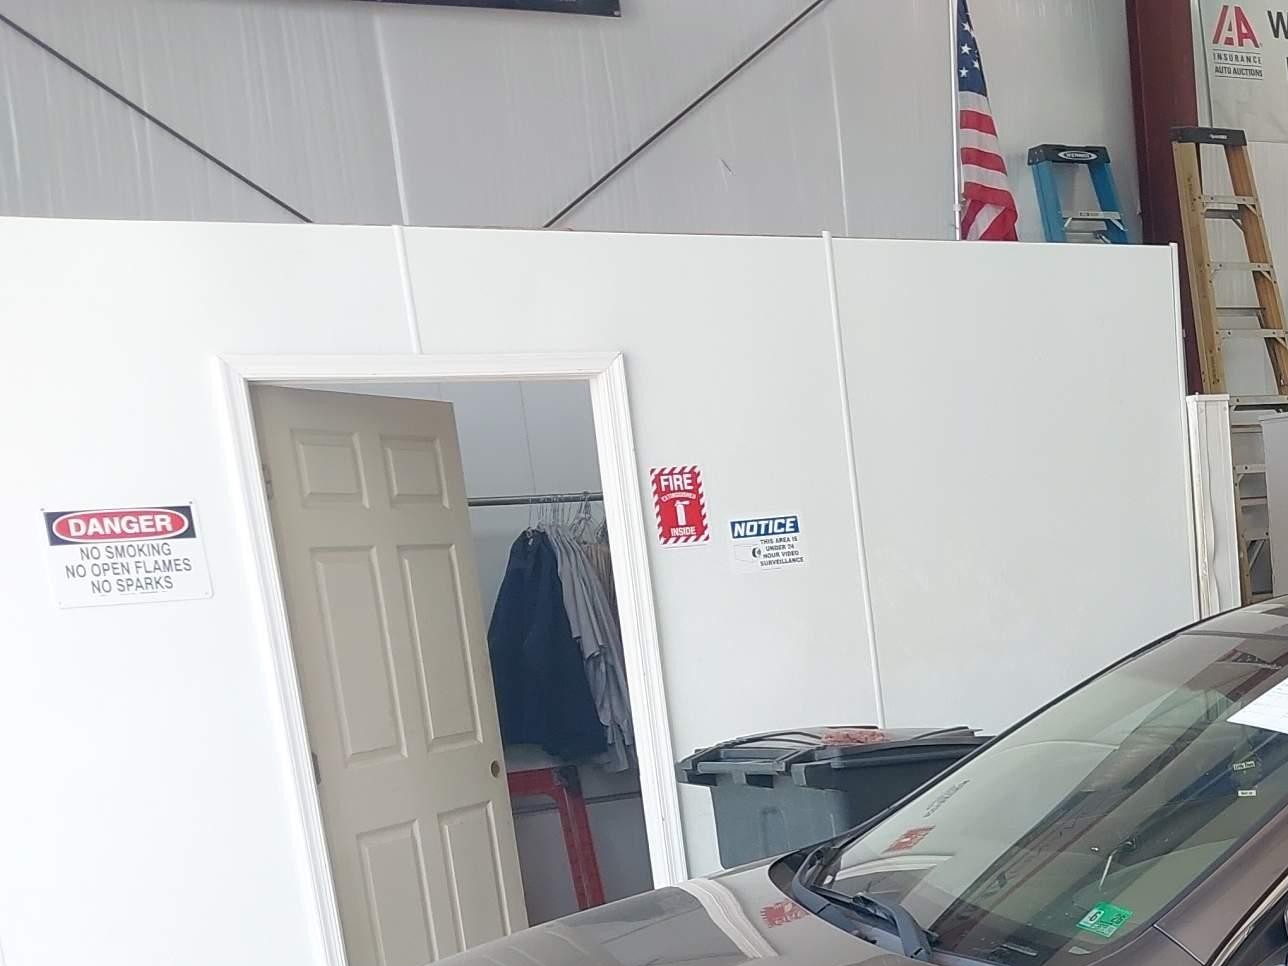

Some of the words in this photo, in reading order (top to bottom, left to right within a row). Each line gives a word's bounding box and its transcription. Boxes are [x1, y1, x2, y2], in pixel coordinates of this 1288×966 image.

[1213, 53, 1262, 64] INSURANCE
[1215, 66, 1232, 75] AUTO
[1233, 67, 1262, 77] AUCTIONS
[660, 474, 694, 491] FIRE
[68, 514, 174, 537] DANGER
[670, 526, 697, 537] INSIDE
[733, 518, 796, 537] NOTICE
[79, 546, 101, 561] NO
[105, 543, 172, 559] SMOKING
[65, 564, 87, 579] NO
[91, 562, 131, 577] OPEN
[134, 558, 192, 575] FLAMES
[760, 557, 804, 566] SURVEILLANCE
[91, 579, 112, 594] NO
[116, 576, 174, 592] SPARKS
